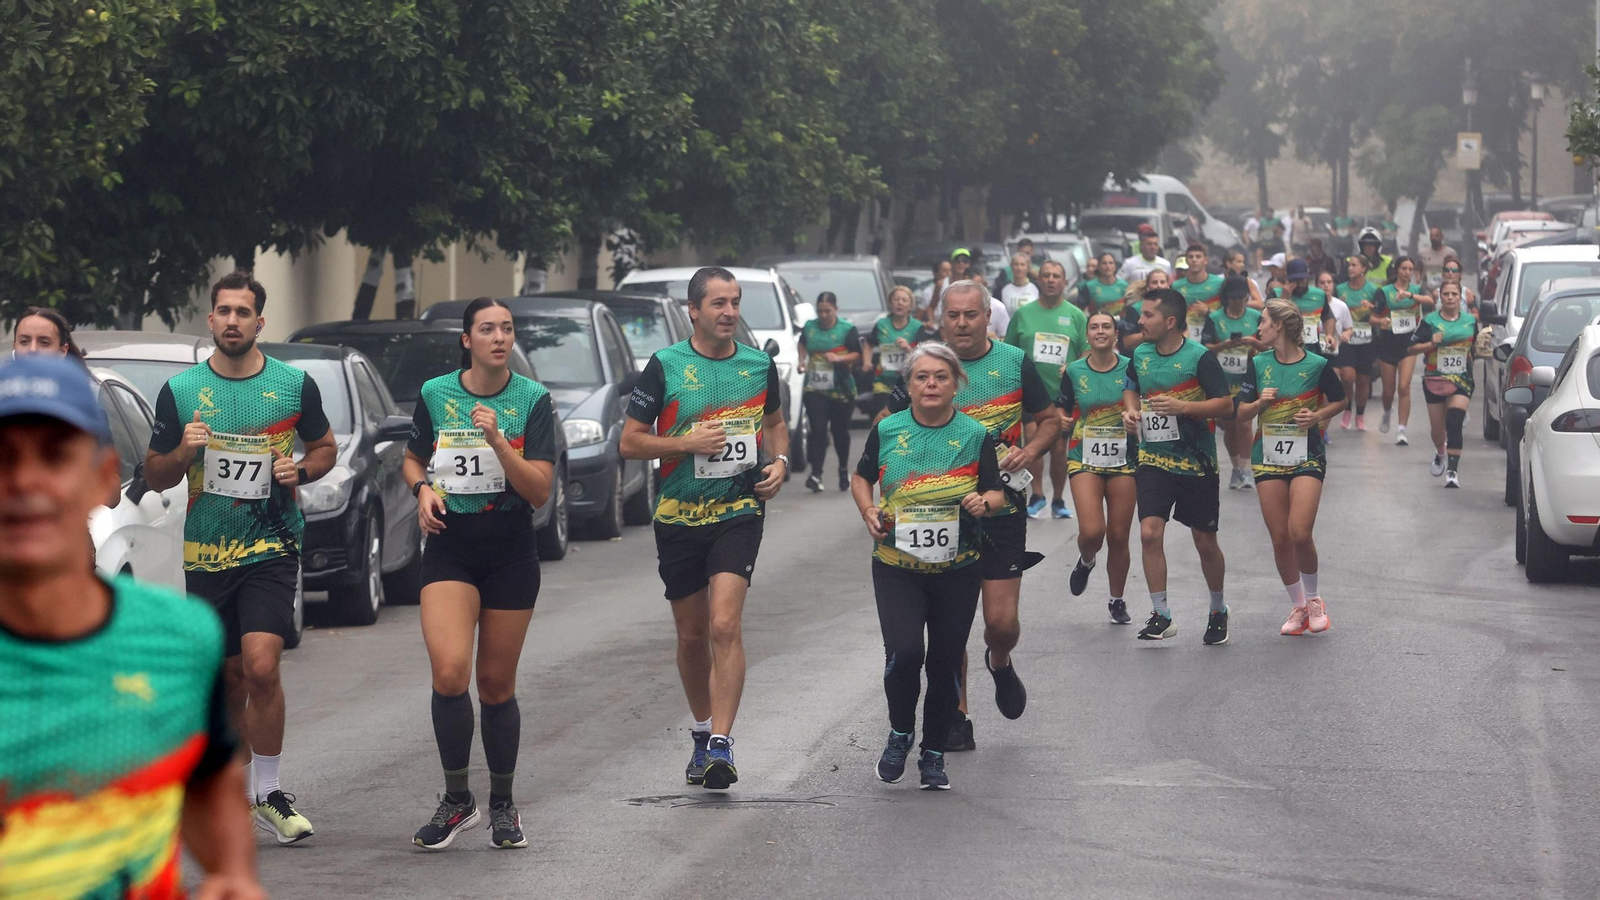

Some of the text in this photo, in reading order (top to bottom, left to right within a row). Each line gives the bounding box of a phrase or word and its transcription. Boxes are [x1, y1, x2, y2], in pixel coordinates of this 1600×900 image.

[1399, 318, 1410, 327] 86
[1040, 344, 1062, 356] 212
[887, 353, 906, 363] 177
[1222, 356, 1241, 367] 281
[1443, 357, 1462, 367] 326
[1146, 416, 1170, 430] 182
[1091, 443, 1119, 456] 415
[1275, 440, 1294, 454] 47
[218, 458, 262, 482] 377
[454, 455, 484, 476] 31
[909, 528, 949, 548] 136
